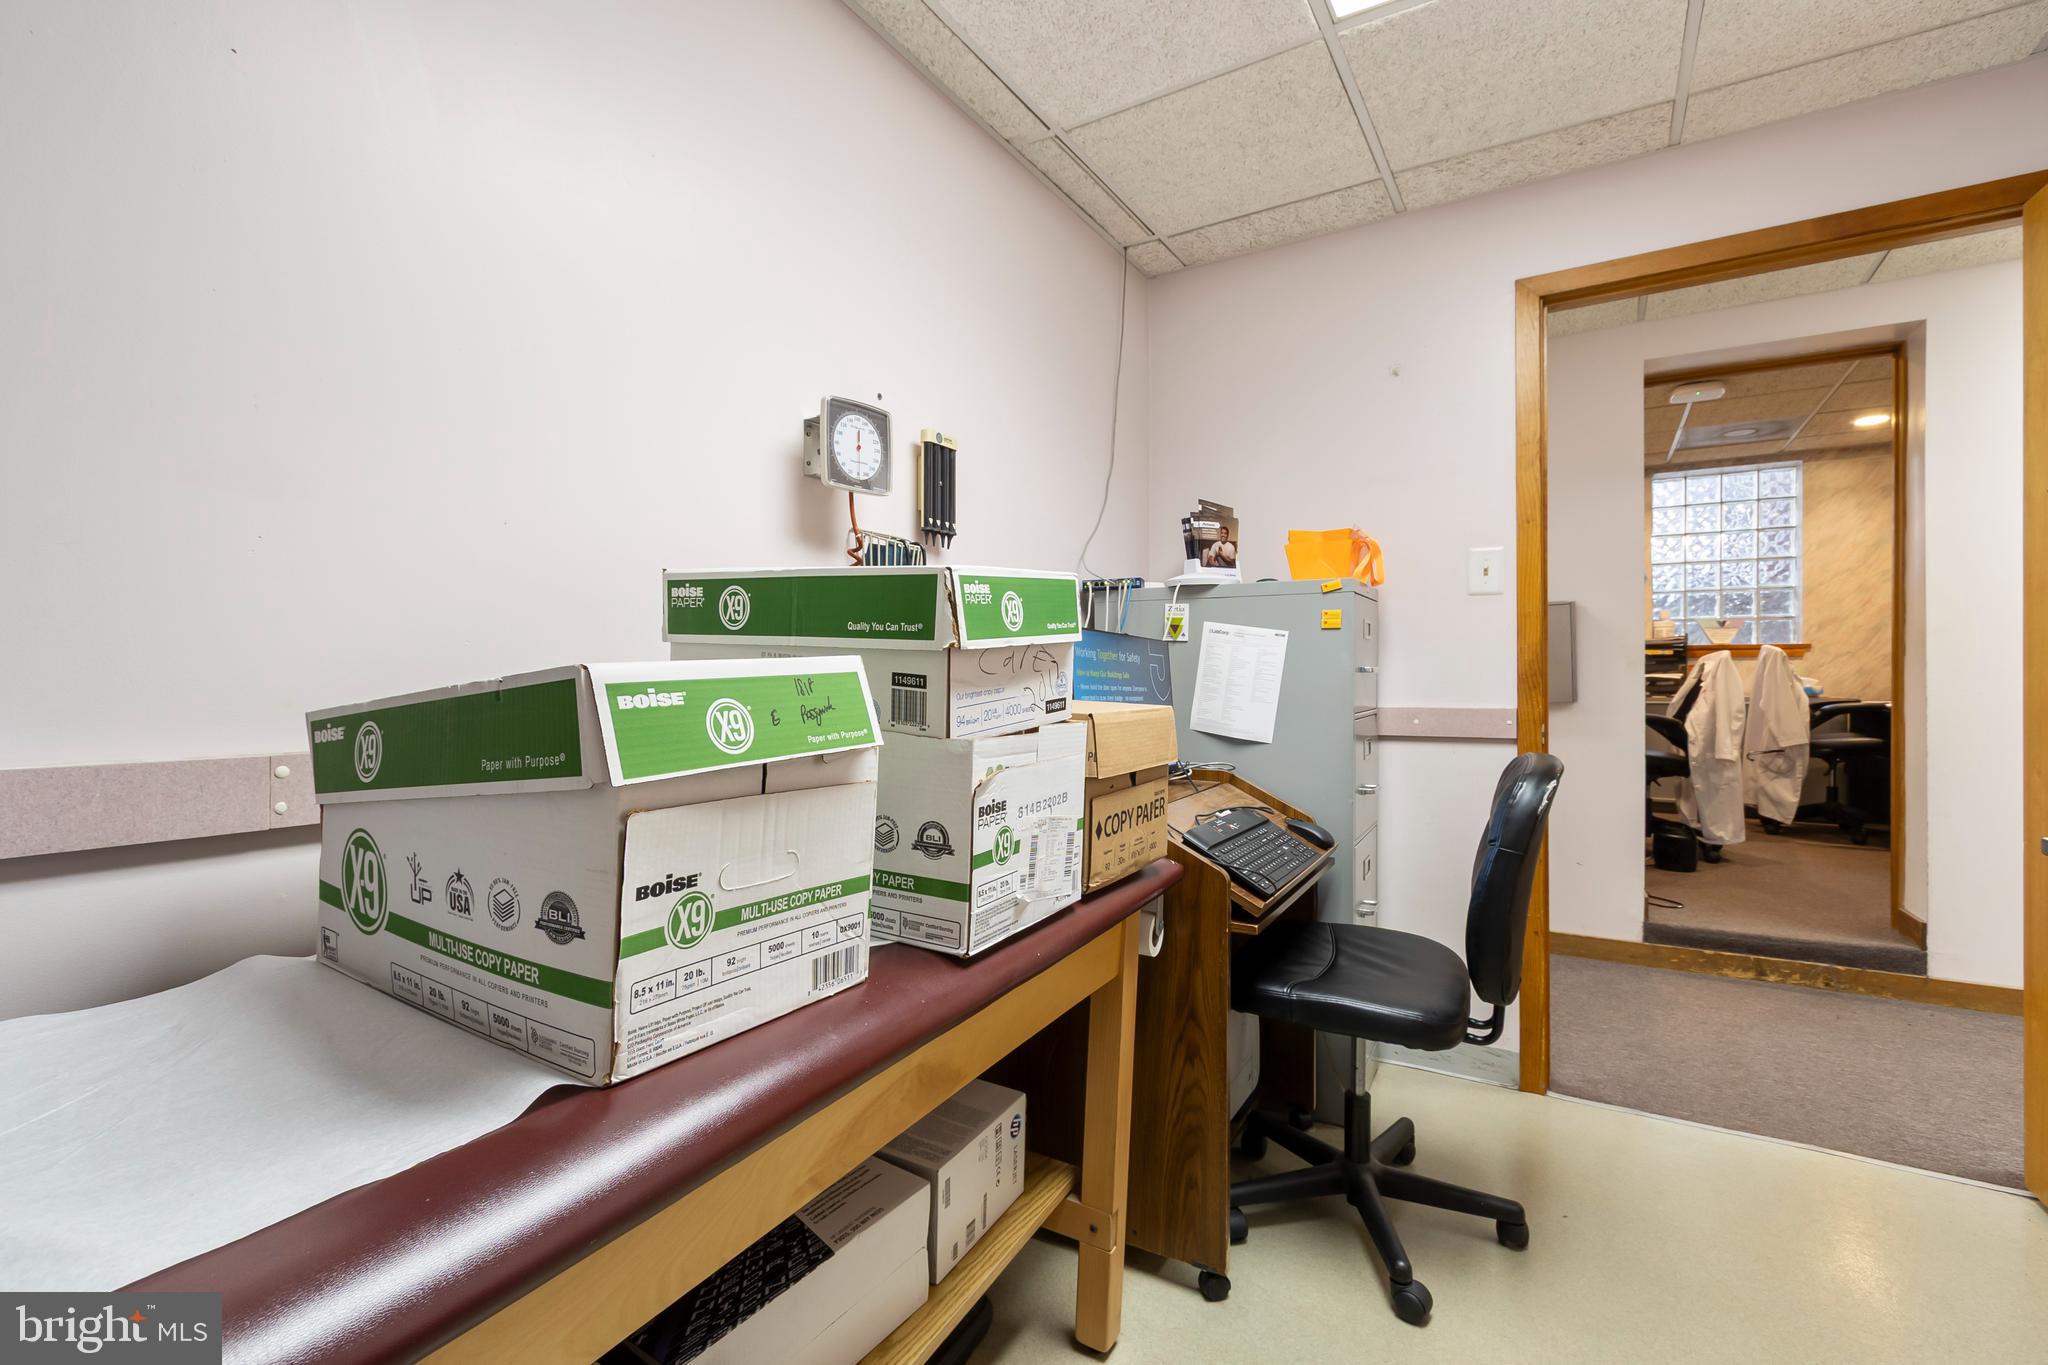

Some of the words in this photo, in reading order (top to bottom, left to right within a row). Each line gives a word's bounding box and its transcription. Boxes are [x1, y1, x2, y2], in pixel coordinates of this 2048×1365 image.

[671, 597, 704, 608] PAPER
[965, 594, 992, 604] PAPER
[847, 621, 870, 632] Quality
[871, 622, 884, 631] You
[885, 622, 899, 631] Can
[1126, 652, 1141, 664] Safety
[894, 676, 924, 686] 1149611
[956, 715, 966, 728] 94
[983, 709, 992, 722] 20
[1005, 704, 1022, 716] 4000
[808, 735, 826, 744] Paper
[827, 732, 840, 741] with
[481, 759, 503, 773] Paper
[505, 757, 522, 769] with
[977, 812, 1007, 831] PAPER
[1103, 807, 1135, 838] COPY
[926, 834, 942, 843] BLI
[882, 873, 915, 890] PAPER
[449, 891, 471, 916] USA
[741, 897, 789, 921] MULTI-USE
[789, 890, 814, 908] COPY
[814, 884, 842, 902] PAPER
[887, 891, 898, 899] AND
[898, 893, 923, 904] PRINTERS
[550, 909, 570, 923] BLI
[736, 925, 758, 937] PREMIUM
[758, 916, 788, 931] PERFORMANCE
[811, 930, 820, 940] 10
[768, 941, 785, 954] 5000
[428, 931, 474, 962] MULTI-USE
[475, 949, 502, 972] COPY
[503, 959, 540, 985] PAPER
[726, 957, 736, 967] 92
[406, 976, 413, 986] 11
[683, 970, 694, 982] 20
[695, 968, 706, 978] lb.
[429, 986, 437, 998] 20
[439, 962, 470, 981] PERFORMANCE
[478, 977, 486, 987] ALL
[487, 980, 508, 995] COPIERS
[510, 988, 520, 999] AND
[521, 992, 548, 1009] PRINTERS
[633, 988, 646, 999] 8.5
[647, 986, 654, 994] x
[655, 981, 665, 991] 11
[665, 979, 675, 988] in.
[461, 1000, 470, 1012] 92
[493, 1013, 510, 1028] 5000
